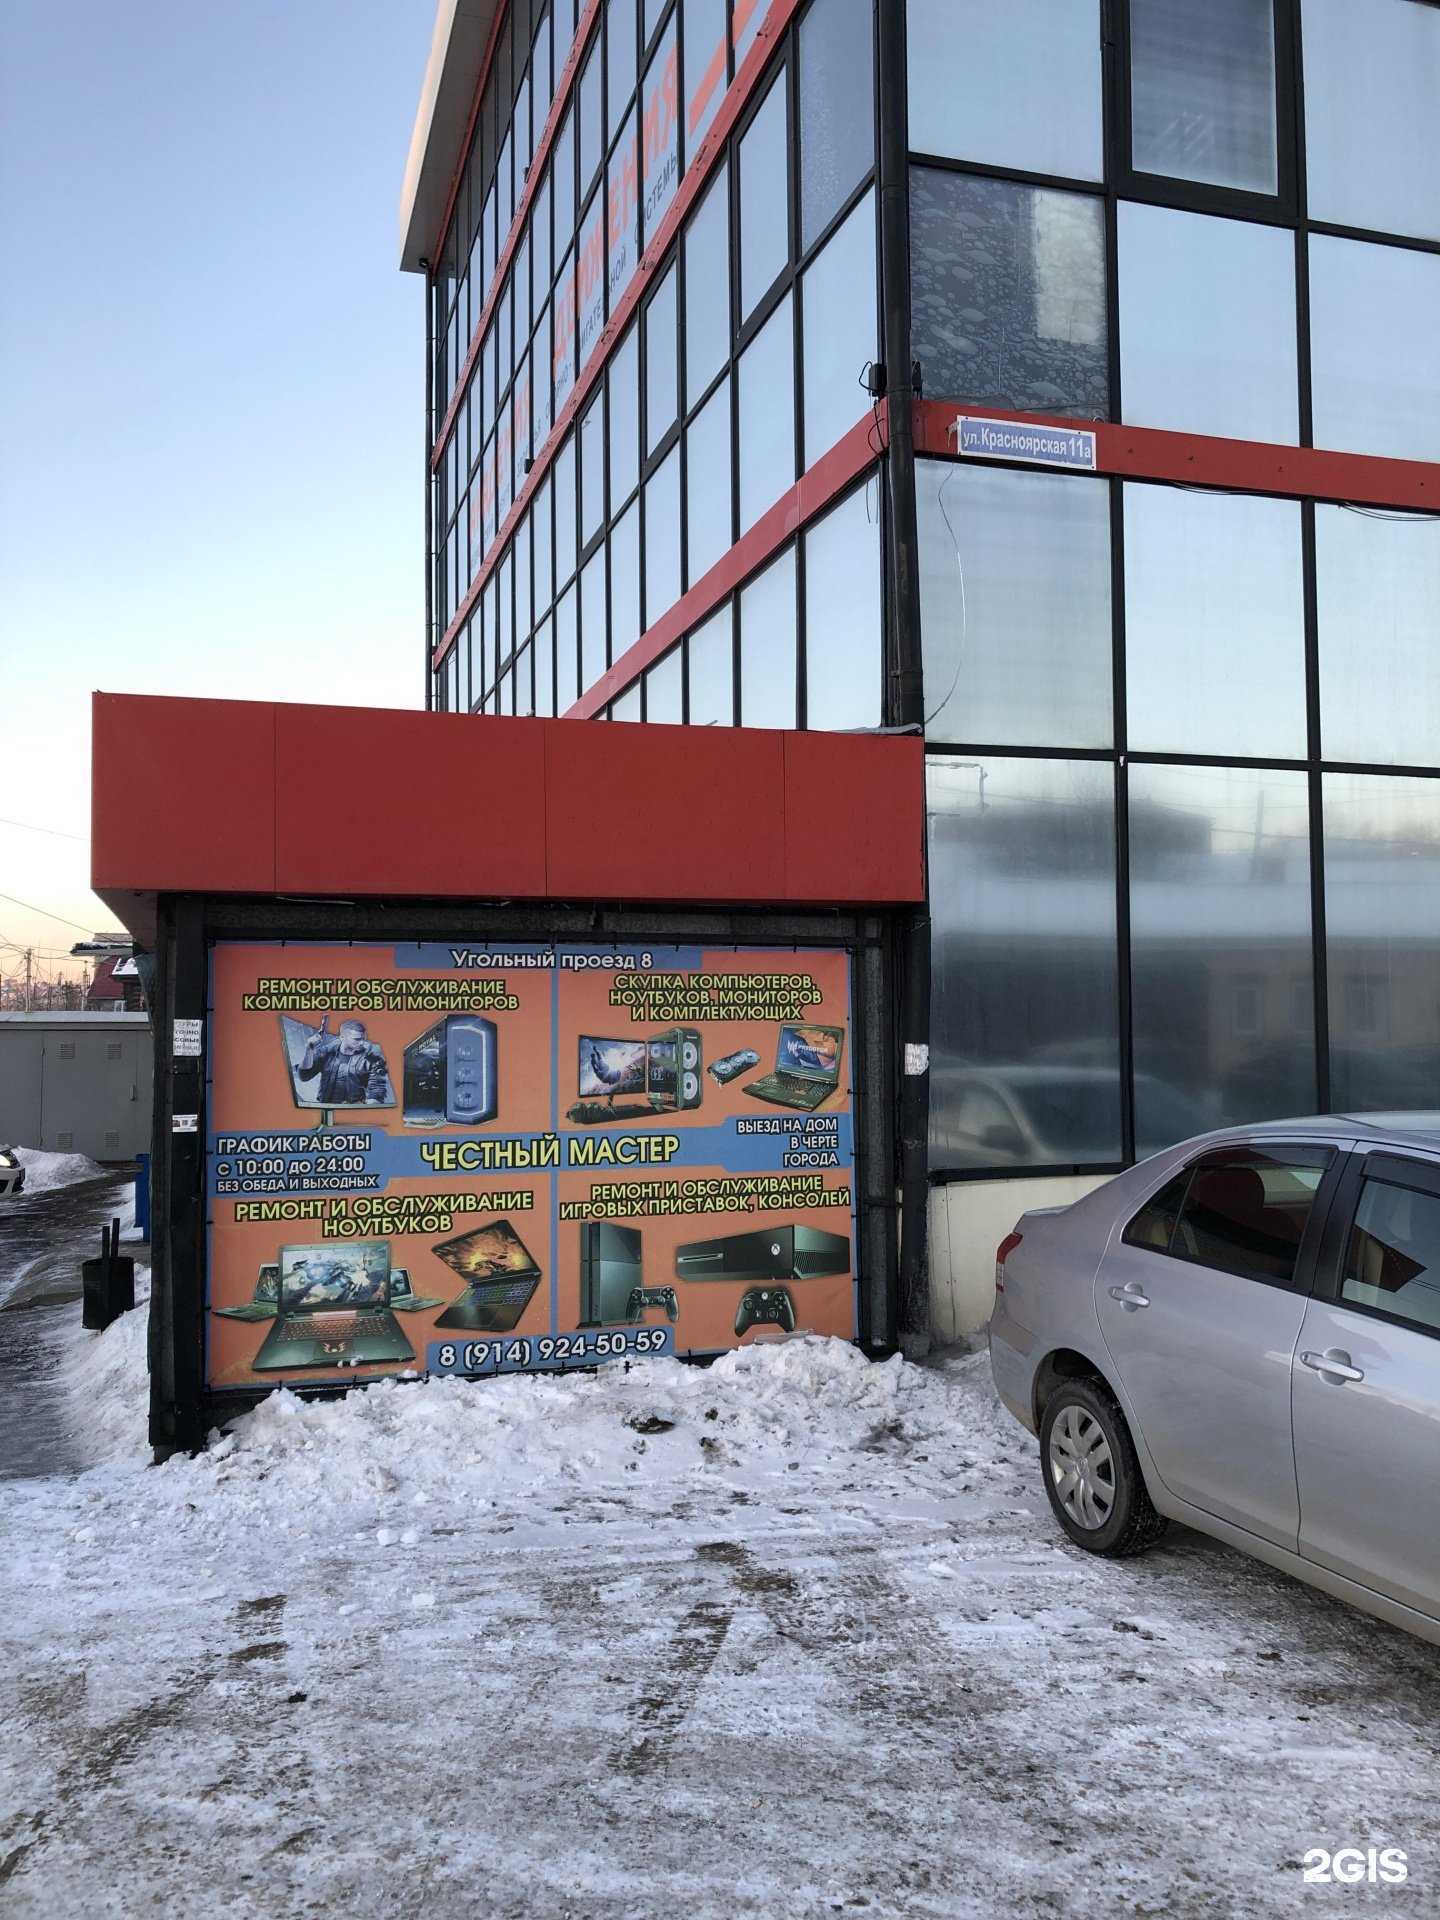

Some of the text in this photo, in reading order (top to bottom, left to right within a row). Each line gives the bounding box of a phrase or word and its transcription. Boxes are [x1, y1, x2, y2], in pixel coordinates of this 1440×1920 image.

[1069, 437, 1092, 458] 11а
[449, 949, 653, 971] Угольный проезд 8
[258, 979, 504, 995] РЕМОНТ И ОБСЛУЖИВАНИЕ
[614, 974, 816, 990] СКУПКА КОМПЬЮТЕРОВ,
[244, 996, 518, 1010] КОМПЬЮТЕРОВ И МОНИТОРОВ
[610, 990, 822, 1005] НОУТБУКОВ, МОНИТОРОВ
[632, 1006, 802, 1021] И КОМПЛЕКТУЮЩИХ
[738, 1118, 838, 1134] ВЫЕЗД НА ДОМ
[218, 1135, 371, 1154] ГРАФИК РАБОТЫ
[420, 1132, 679, 1170] ЧЕСТНЫЙ МАСТЕР
[791, 1135, 838, 1149] В ЧЕРТЕ
[236, 1158, 284, 1175] 10:00
[288, 1160, 312, 1176] до
[315, 1157, 364, 1172] 24:00
[784, 1153, 839, 1168] ГОРОДА
[217, 1176, 377, 1192] БЕЗ ОБЕДА И ВЫХОДНЫХ
[591, 1176, 822, 1200] РЕМОНТ И ОБСЛУЖИВАНИЕ
[235, 1192, 533, 1220] РЕМОНТ И ОБСЛУЖИВАНИЕ
[560, 1188, 850, 1219] ИГРОВЫХ ПРИСТАВОК, КОНСОЛЕЙ
[323, 1214, 452, 1236] НОУТБУКОВ
[439, 1331, 668, 1369] 8 (914) 924-50-59
